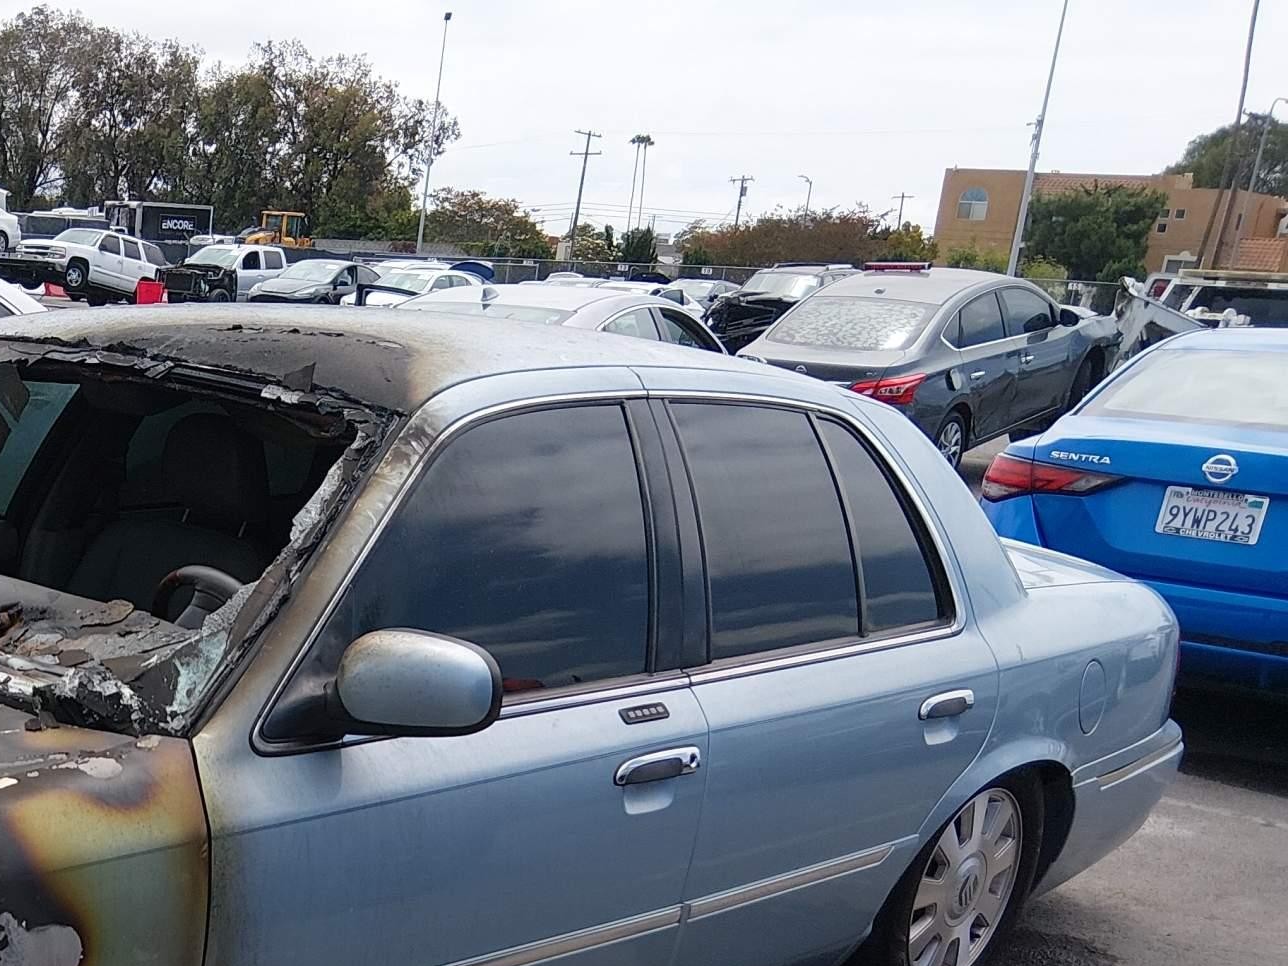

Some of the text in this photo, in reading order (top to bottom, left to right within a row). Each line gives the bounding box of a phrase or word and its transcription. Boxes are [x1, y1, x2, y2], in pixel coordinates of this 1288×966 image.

[1049, 450, 1111, 464] SENTRA
[1165, 504, 1256, 536] 9YWP243
[1179, 527, 1233, 541] CHEVROLET
